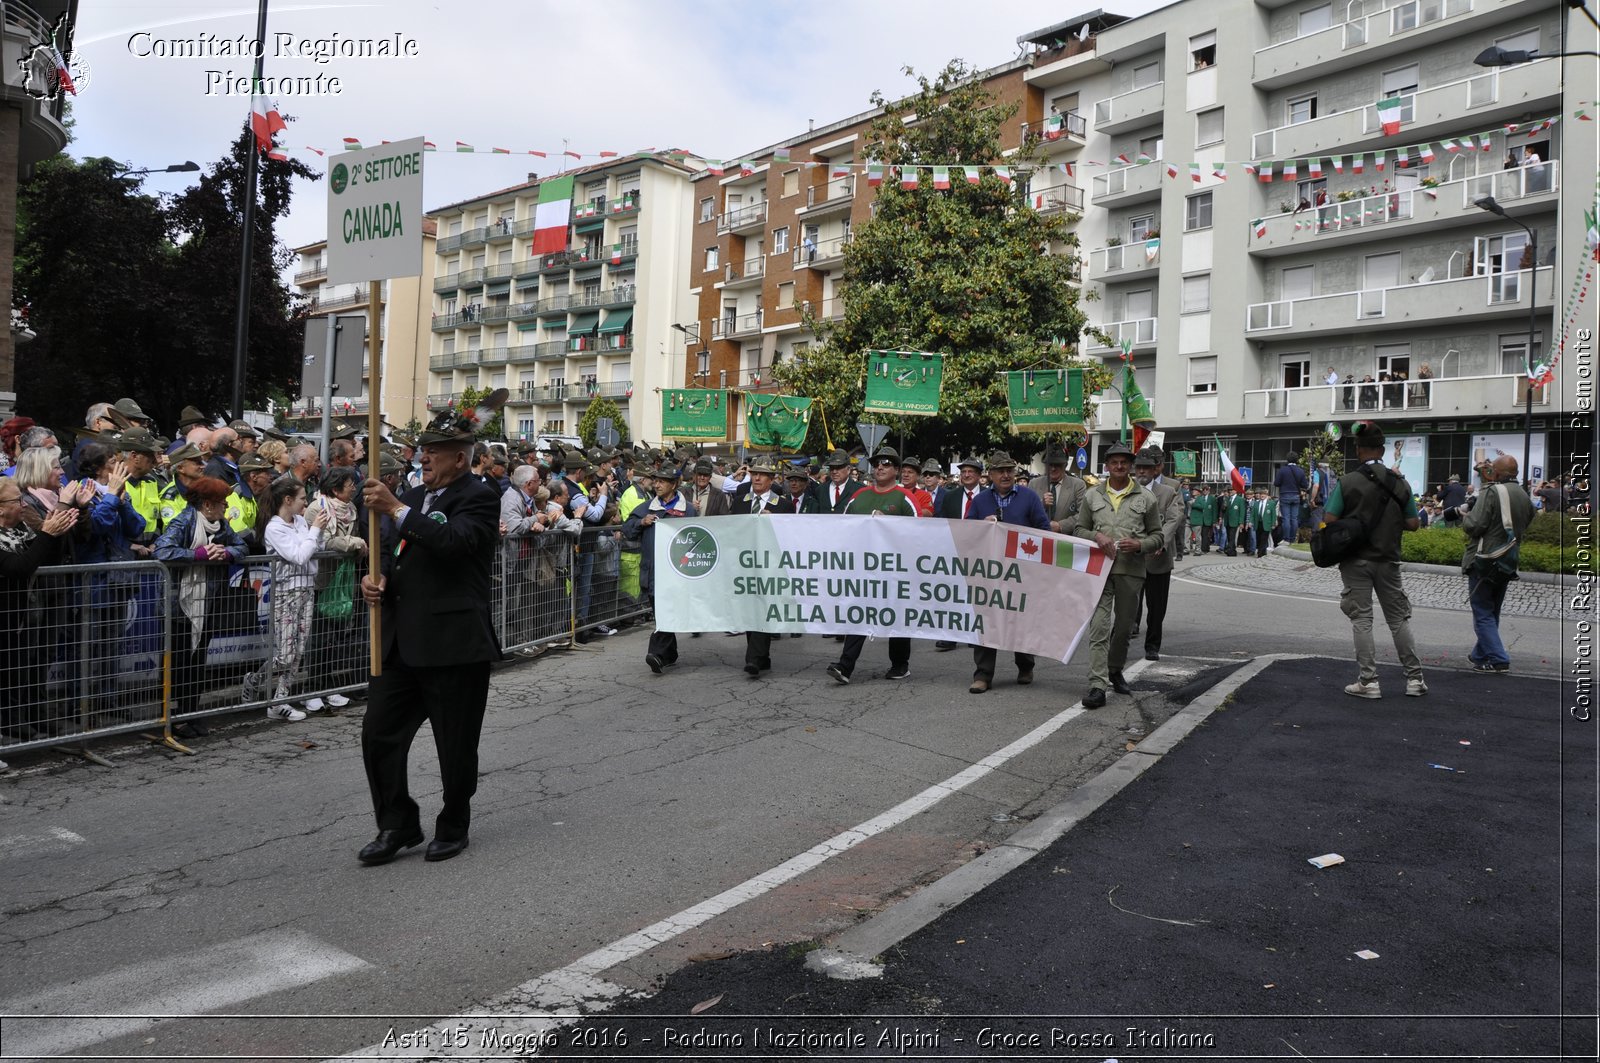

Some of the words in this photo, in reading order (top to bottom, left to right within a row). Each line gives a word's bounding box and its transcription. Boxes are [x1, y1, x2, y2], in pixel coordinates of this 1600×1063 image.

[365, 152, 420, 183] SETTORE
[343, 201, 403, 244] CANADA
[870, 400, 897, 408] SEZIONE
[1013, 408, 1039, 417] SEZIONE
[1043, 406, 1079, 415] MONTREAL
[739, 550, 769, 568] GLI
[778, 551, 854, 570] ALPINI
[864, 552, 908, 572] DEL
[916, 555, 1022, 584] CANADA
[733, 577, 819, 596] SEMPRE
[827, 578, 888, 599] UNITI
[897, 580, 910, 600] E
[919, 582, 1027, 613] SOLIDALI
[765, 604, 827, 623] ALLA
[834, 605, 896, 627] LORO
[904, 608, 985, 635] PATRIA
